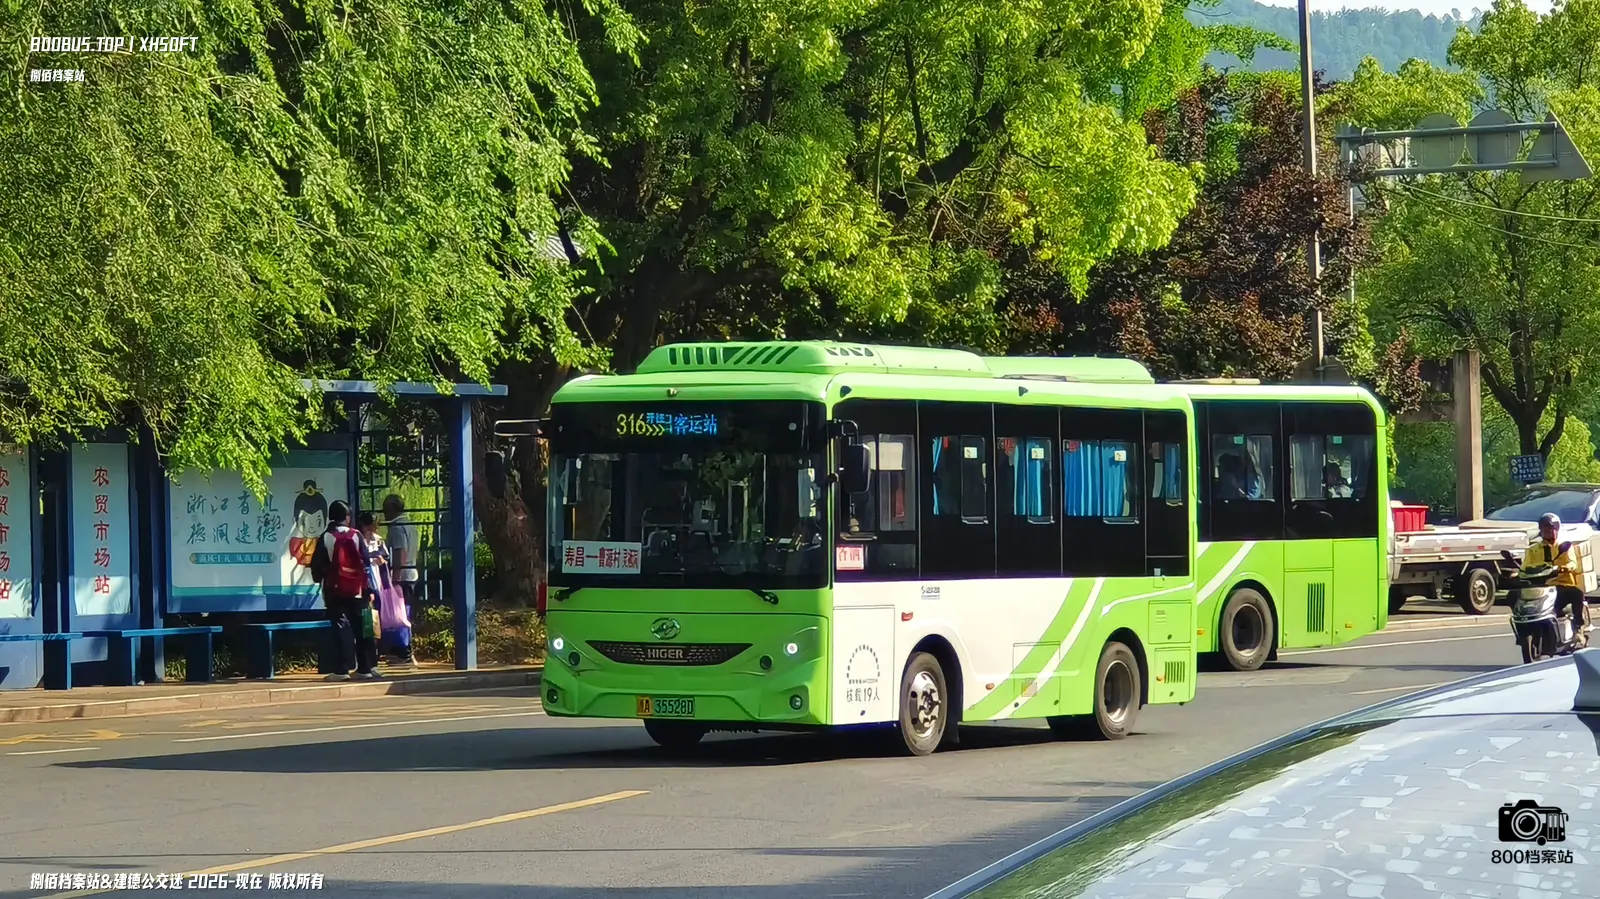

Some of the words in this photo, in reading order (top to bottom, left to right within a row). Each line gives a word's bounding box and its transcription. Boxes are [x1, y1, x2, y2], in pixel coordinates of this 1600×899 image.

[616, 413, 646, 435] 316
[92, 465, 111, 594] 农贸市场站
[647, 648, 684, 659] HIGER
